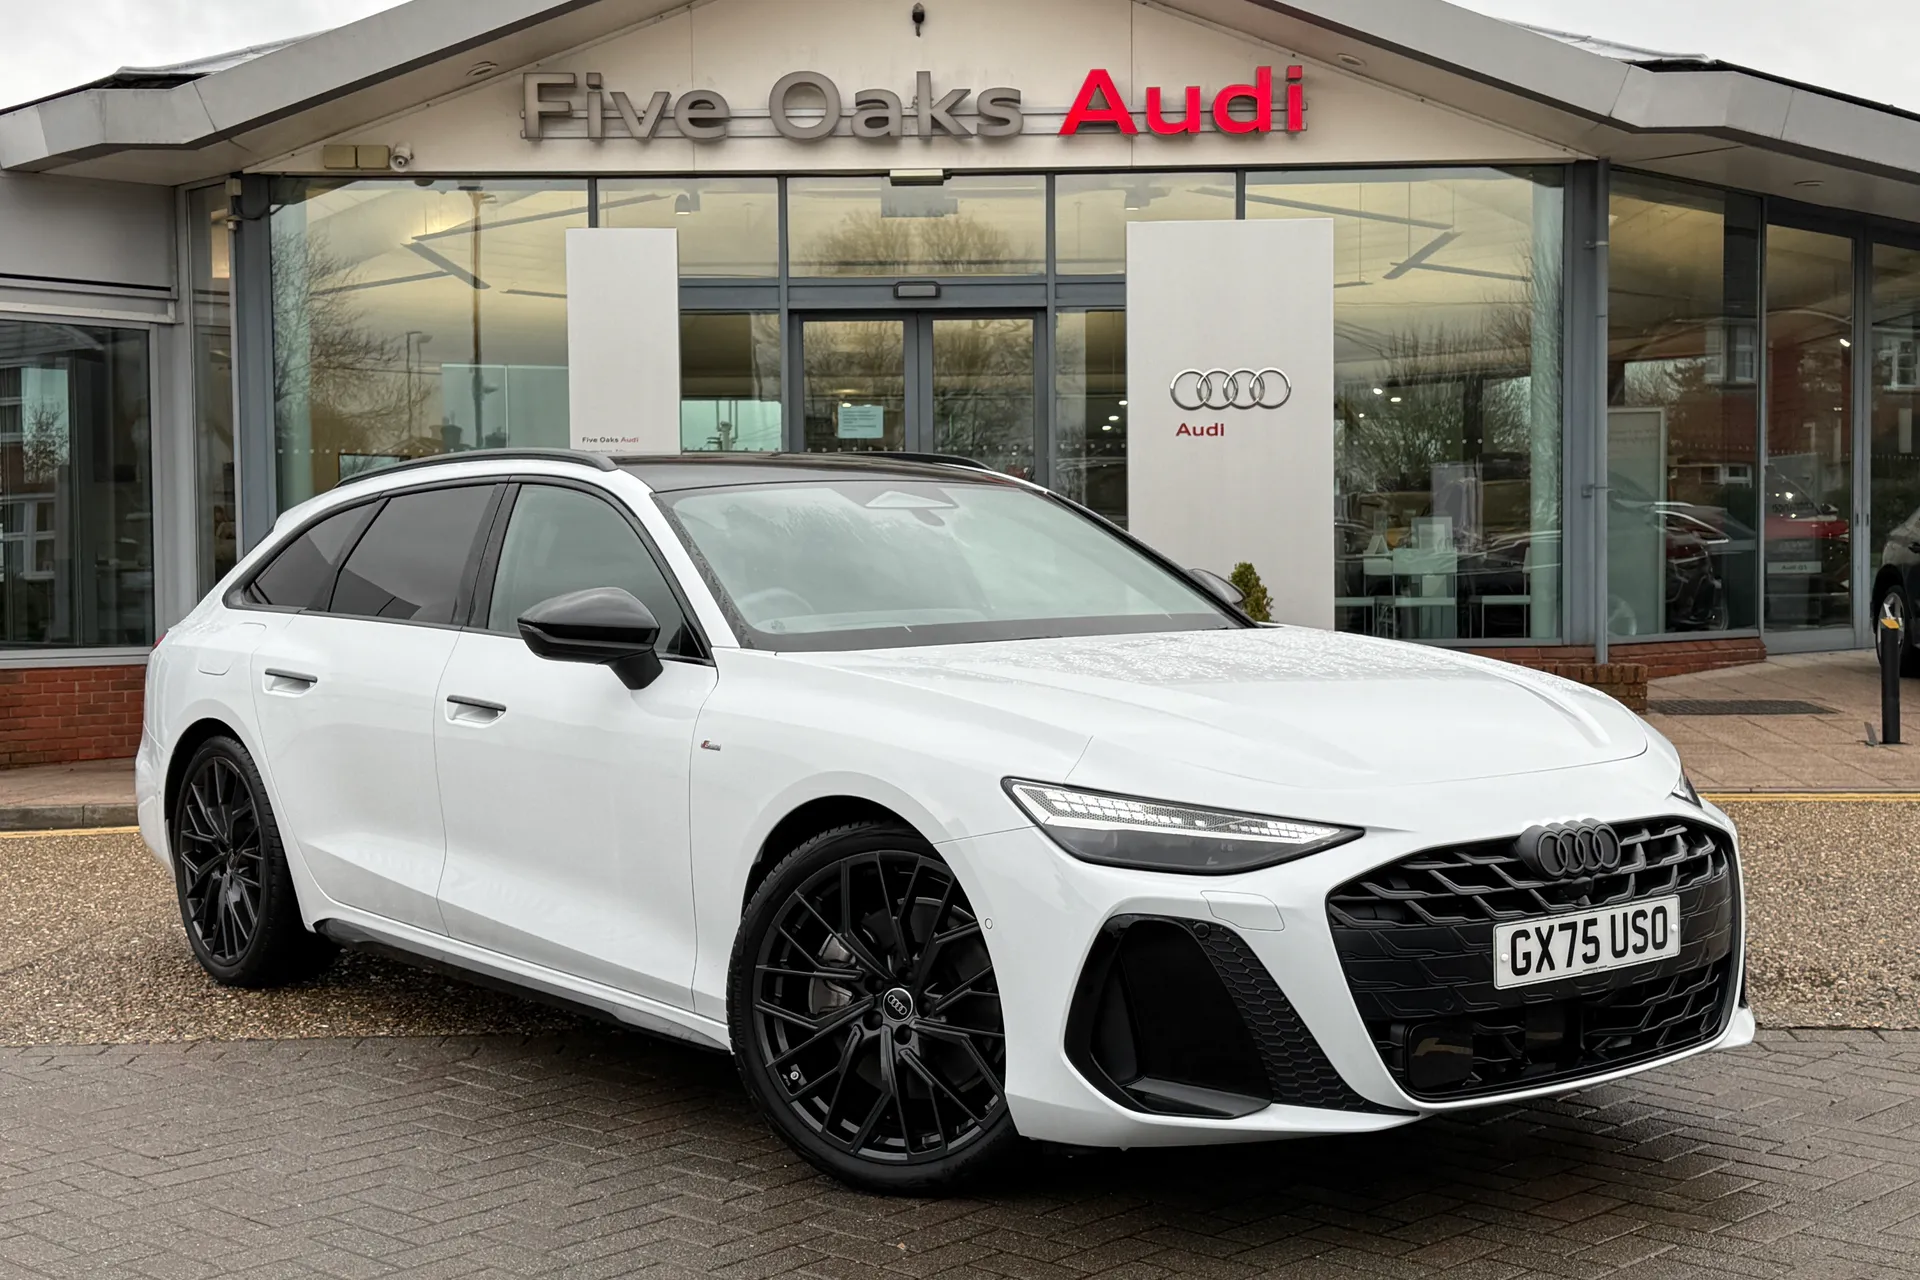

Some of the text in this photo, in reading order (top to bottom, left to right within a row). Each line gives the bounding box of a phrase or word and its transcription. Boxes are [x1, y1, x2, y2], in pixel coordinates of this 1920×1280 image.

[523, 65, 1303, 142] Five Oaks Audi
[1176, 422, 1225, 437] Audi
[1510, 905, 1668, 977] GX75 USO
